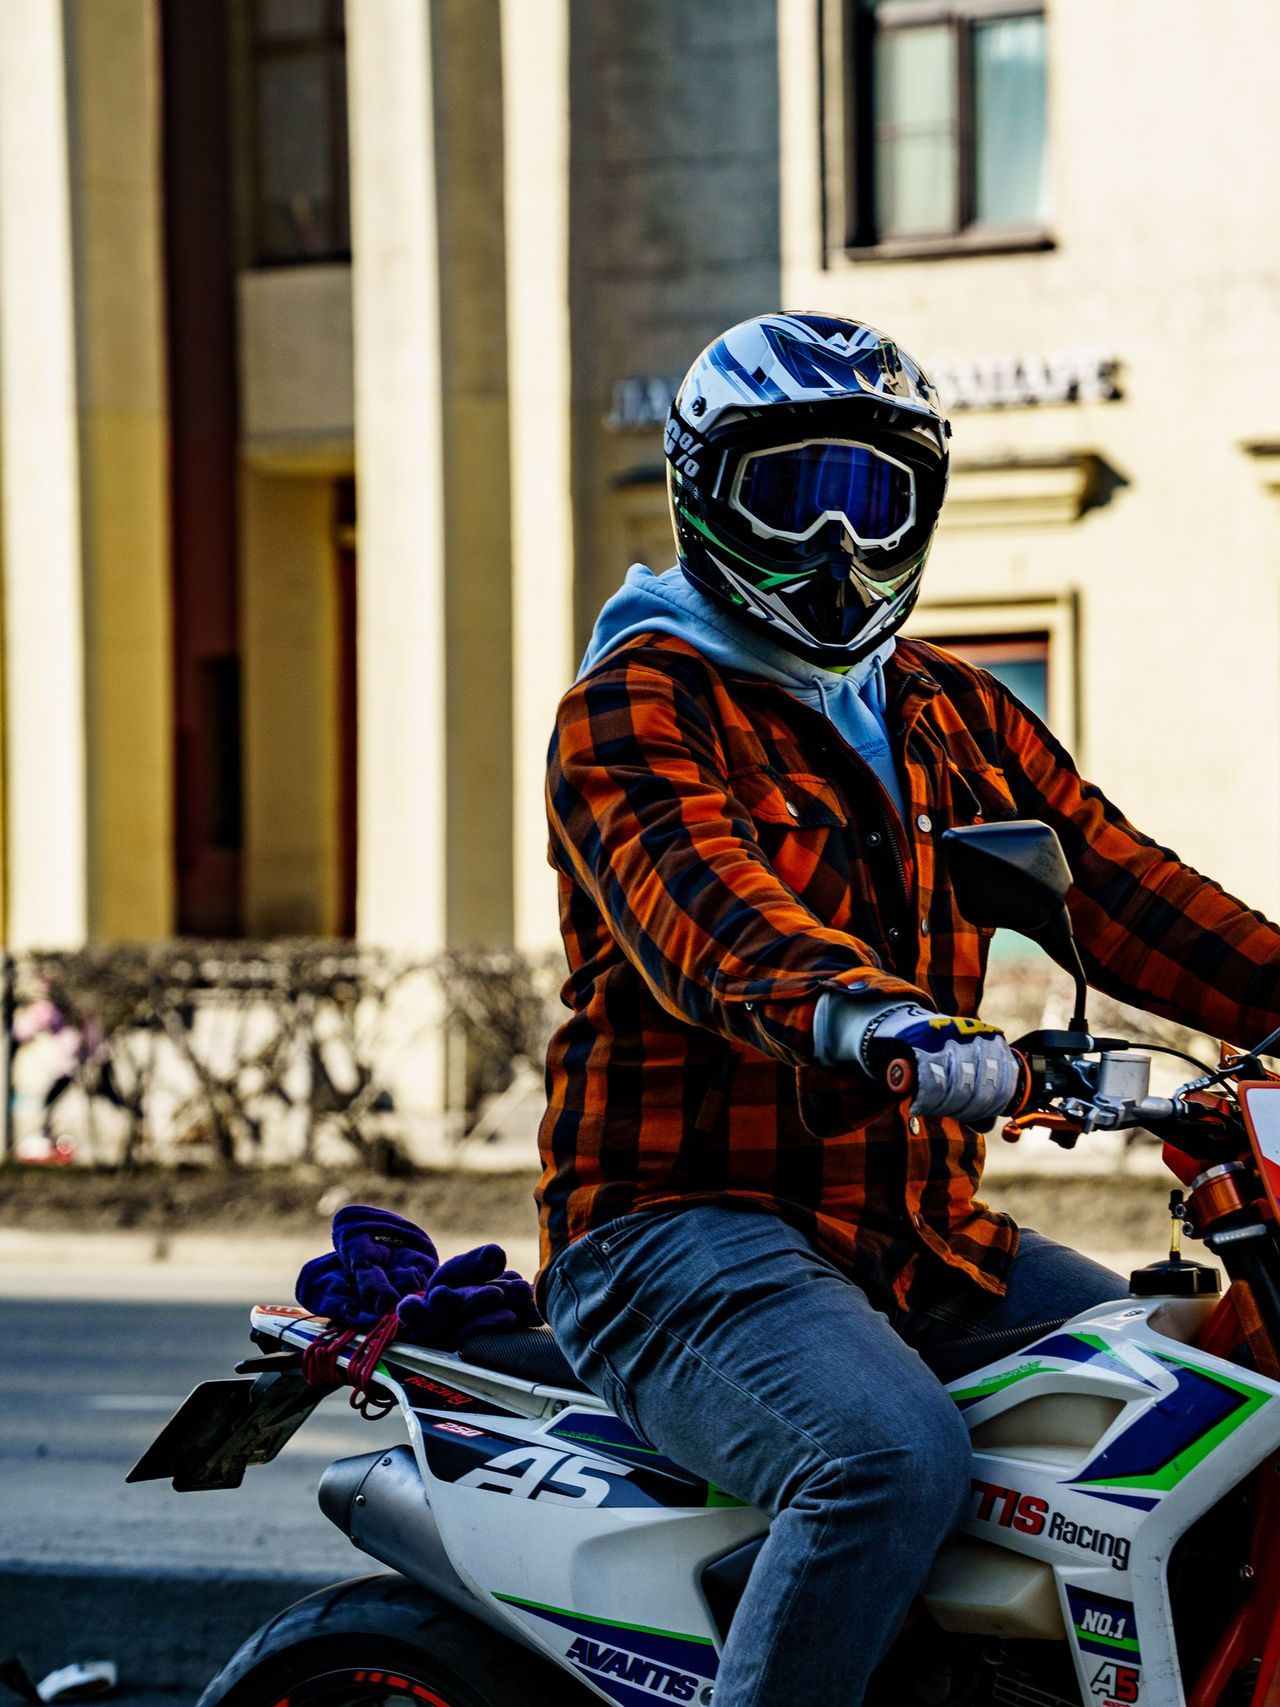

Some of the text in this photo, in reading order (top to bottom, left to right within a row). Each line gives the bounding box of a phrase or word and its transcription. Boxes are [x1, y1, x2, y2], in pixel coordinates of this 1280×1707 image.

[404, 1376, 474, 1405] Racing
[432, 1422, 486, 1439] 250
[452, 1446, 636, 1509] A5
[1048, 1512, 1131, 1571] Racing
[1079, 1608, 1127, 1641] NO.1
[565, 1636, 700, 1702] AVANTIS
[1089, 1661, 1140, 1704] A5
